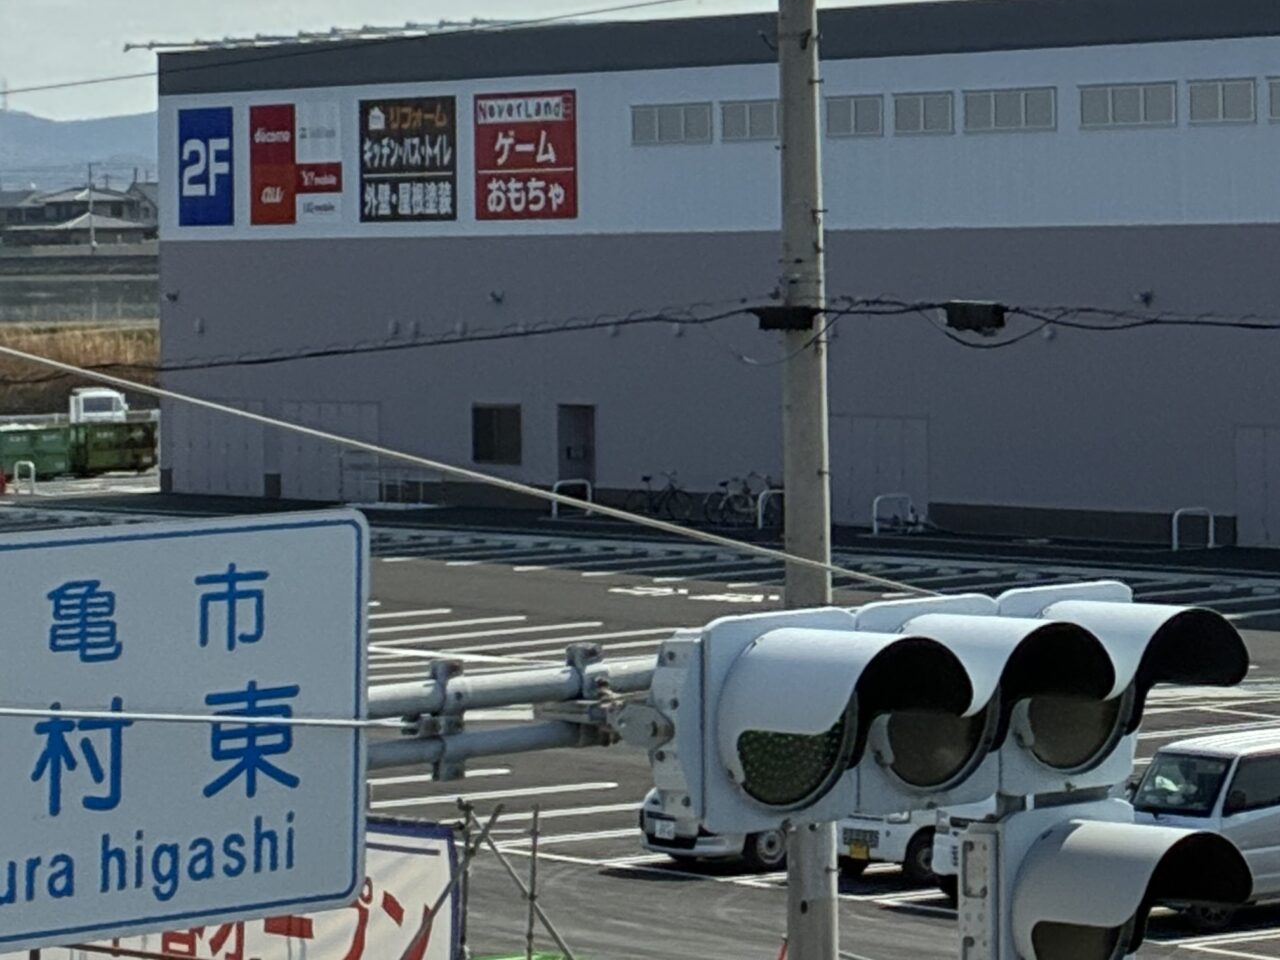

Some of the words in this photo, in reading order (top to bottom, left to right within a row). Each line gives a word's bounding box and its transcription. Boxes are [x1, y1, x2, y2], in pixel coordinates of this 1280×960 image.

[389, 104, 447, 130] リフォーム
[495, 130, 556, 166] ゲーム
[182, 137, 230, 197] 2F
[487, 178, 565, 212] おもちゃ
[100, 810, 295, 902] higashi
